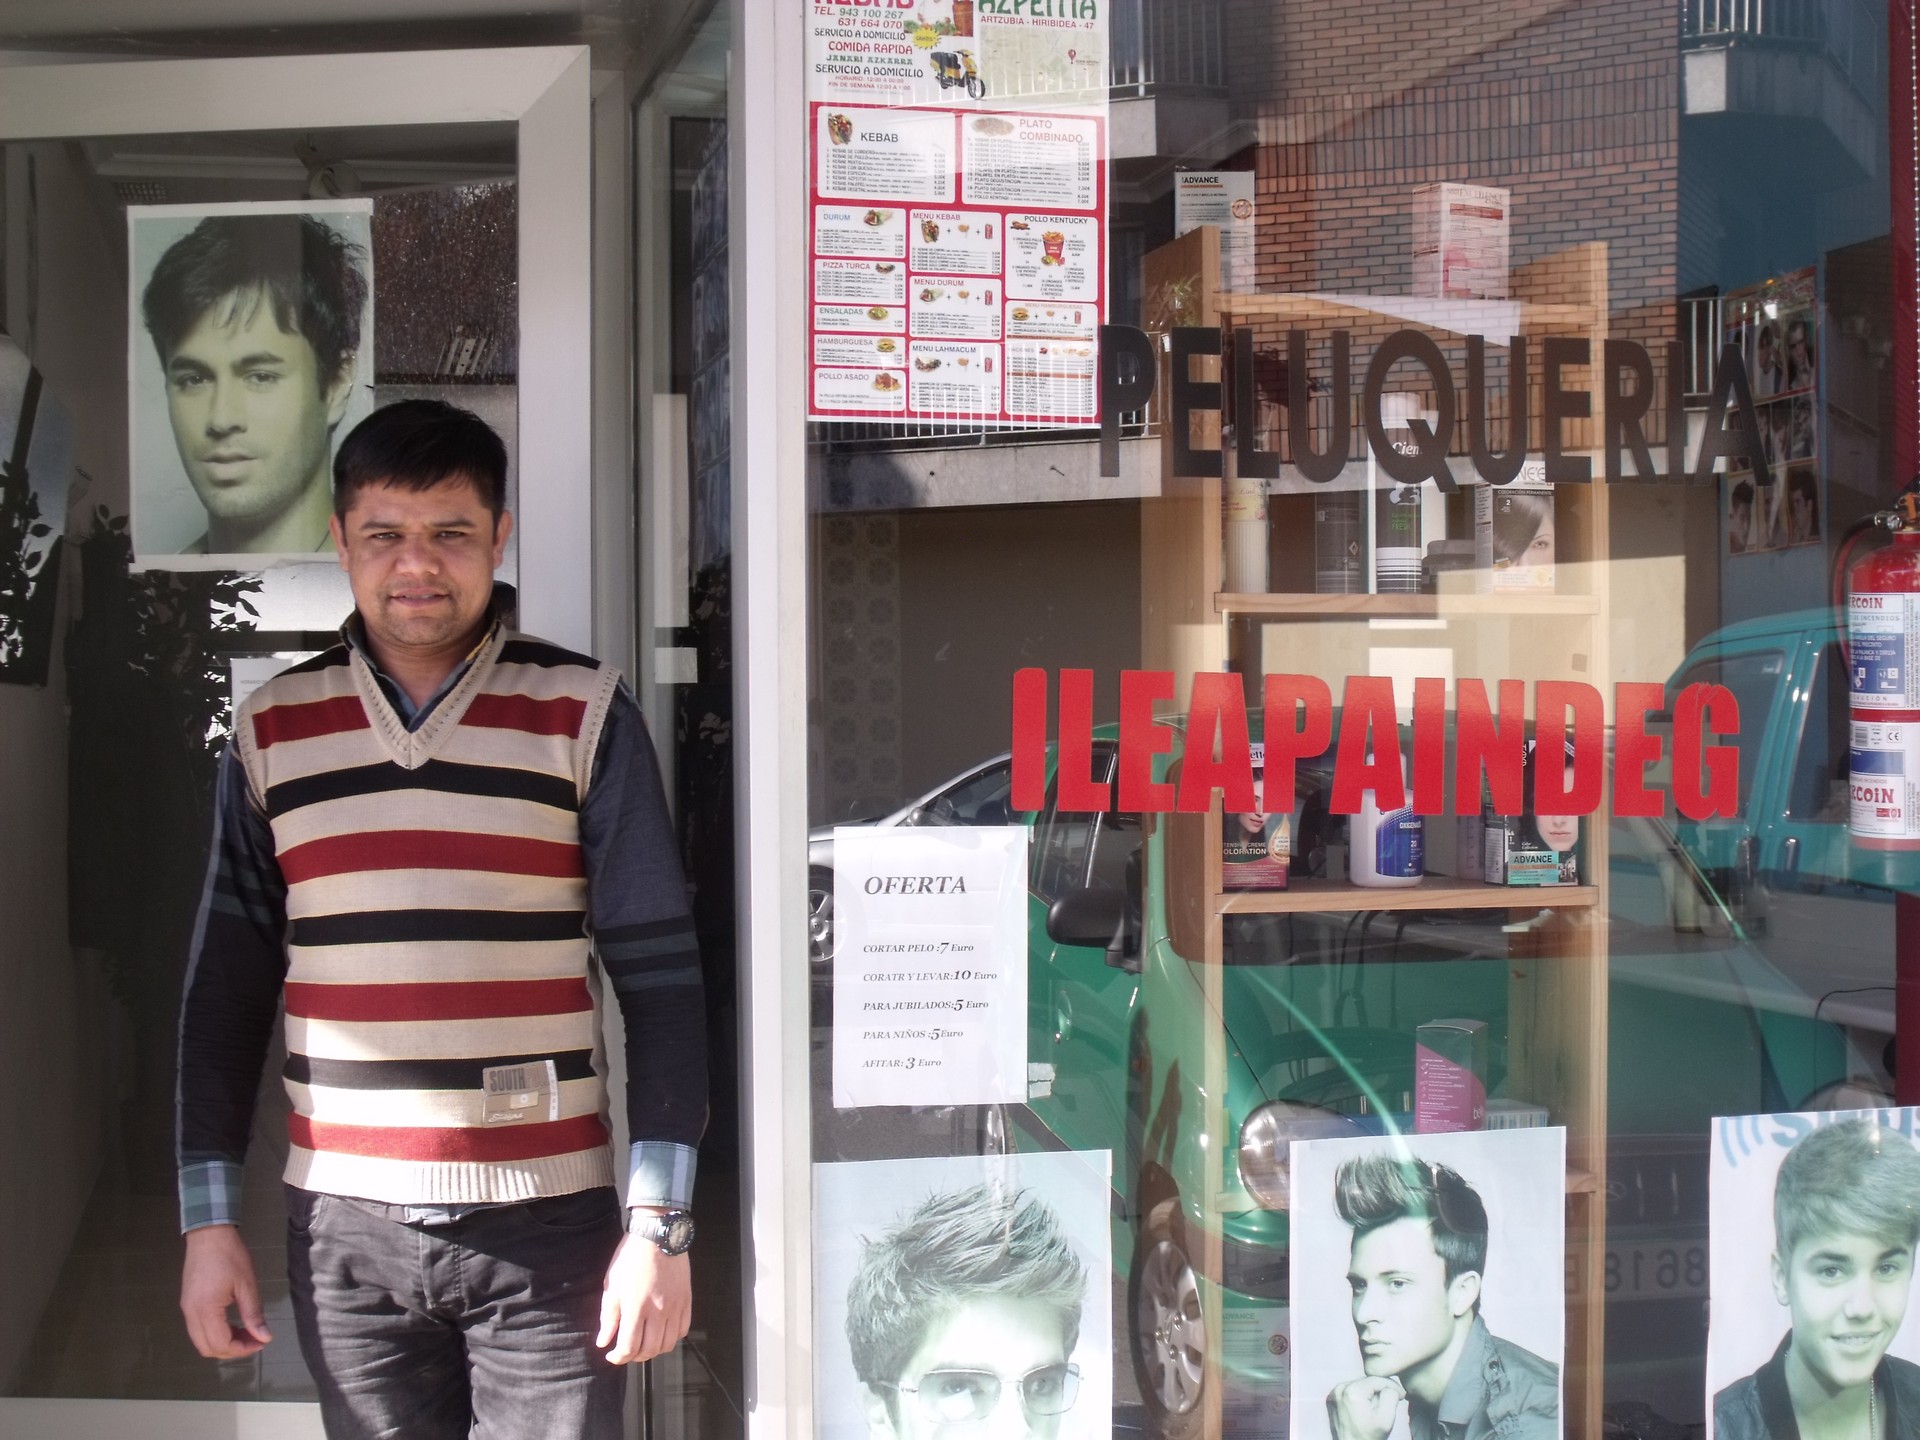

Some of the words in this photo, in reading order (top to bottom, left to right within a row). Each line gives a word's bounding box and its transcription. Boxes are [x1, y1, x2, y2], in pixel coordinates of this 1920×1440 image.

[814, 6, 835, 16] TEL.
[840, 8, 858, 16] 943
[864, 10, 881, 18] 100
[885, 10, 904, 18] 267
[838, 18, 856, 26] 631
[861, 19, 879, 27] 664
[883, 20, 902, 28] 070
[981, 16, 1024, 24] ARTZUBIA
[1032, 19, 1076, 28] HIRIBIDEA
[815, 28, 852, 38] SERVICIO
[864, 30, 906, 40] DOMICILIO
[828, 41, 870, 52] COMIDA
[874, 43, 913, 54] RAPIDA
[867, 57, 913, 65] AZKARRA
[815, 64, 860, 74] SERVICIO
[864, 66, 870, 75] A
[874, 67, 923, 78] DOMICILIO
[1020, 119, 1052, 128] PLATO
[860, 132, 898, 142] KEBAB
[1020, 132, 1083, 143] COMBINADO
[1100, 325, 1772, 493] PELUQUERIA
[1012, 668, 1740, 820] ILEAPAINDEG
[1514, 855, 1552, 863] ADVANCE
[864, 876, 967, 894] OFERTA
[863, 944, 906, 953] CORTAR
[907, 944, 934, 952] PELO
[951, 944, 974, 952] Euro
[863, 973, 905, 982] CORATR
[908, 973, 915, 981] Y
[974, 971, 997, 980] Euro
[863, 1002, 891, 1010] PARA
[966, 1001, 989, 1009] Euro
[863, 1031, 890, 1039] PARA
[893, 1029, 926, 1039] NIÑOS
[862, 1059, 904, 1068] AFITAR:
[906, 1057, 915, 1069] 3
[918, 1058, 941, 1067] Euro
[489, 1068, 525, 1092] SOUTH
